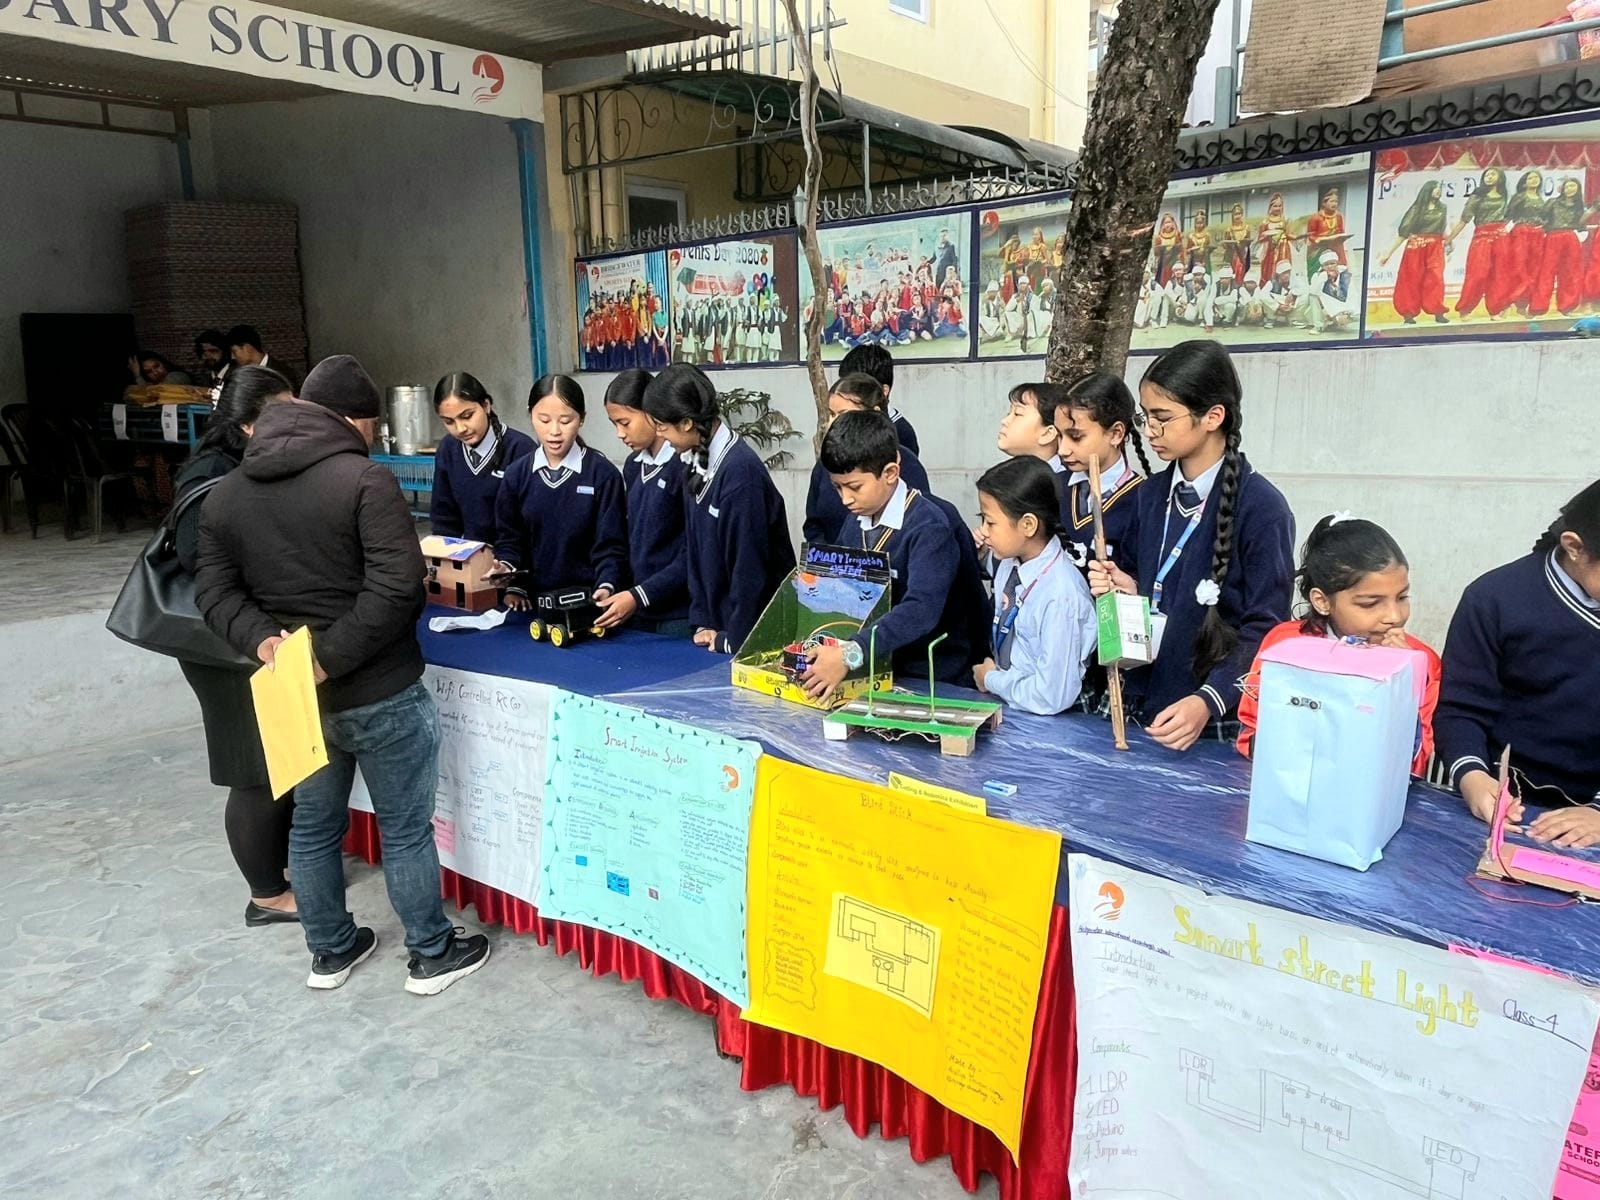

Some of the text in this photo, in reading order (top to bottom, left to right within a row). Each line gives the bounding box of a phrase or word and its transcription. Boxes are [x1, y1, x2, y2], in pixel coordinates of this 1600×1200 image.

[0, 0, 461, 96] ARY SCHOOL
[735, 246, 760, 266] 2080
[806, 547, 844, 564] SMART
[603, 725, 628, 750] Smart
[1173, 903, 1480, 1036] Smart street Light
[1099, 1071, 1128, 1094] LDR
[1429, 1140, 1464, 1166] LED
[1564, 1139, 1600, 1160] ATER
[1567, 1150, 1600, 1168] SCHOO
